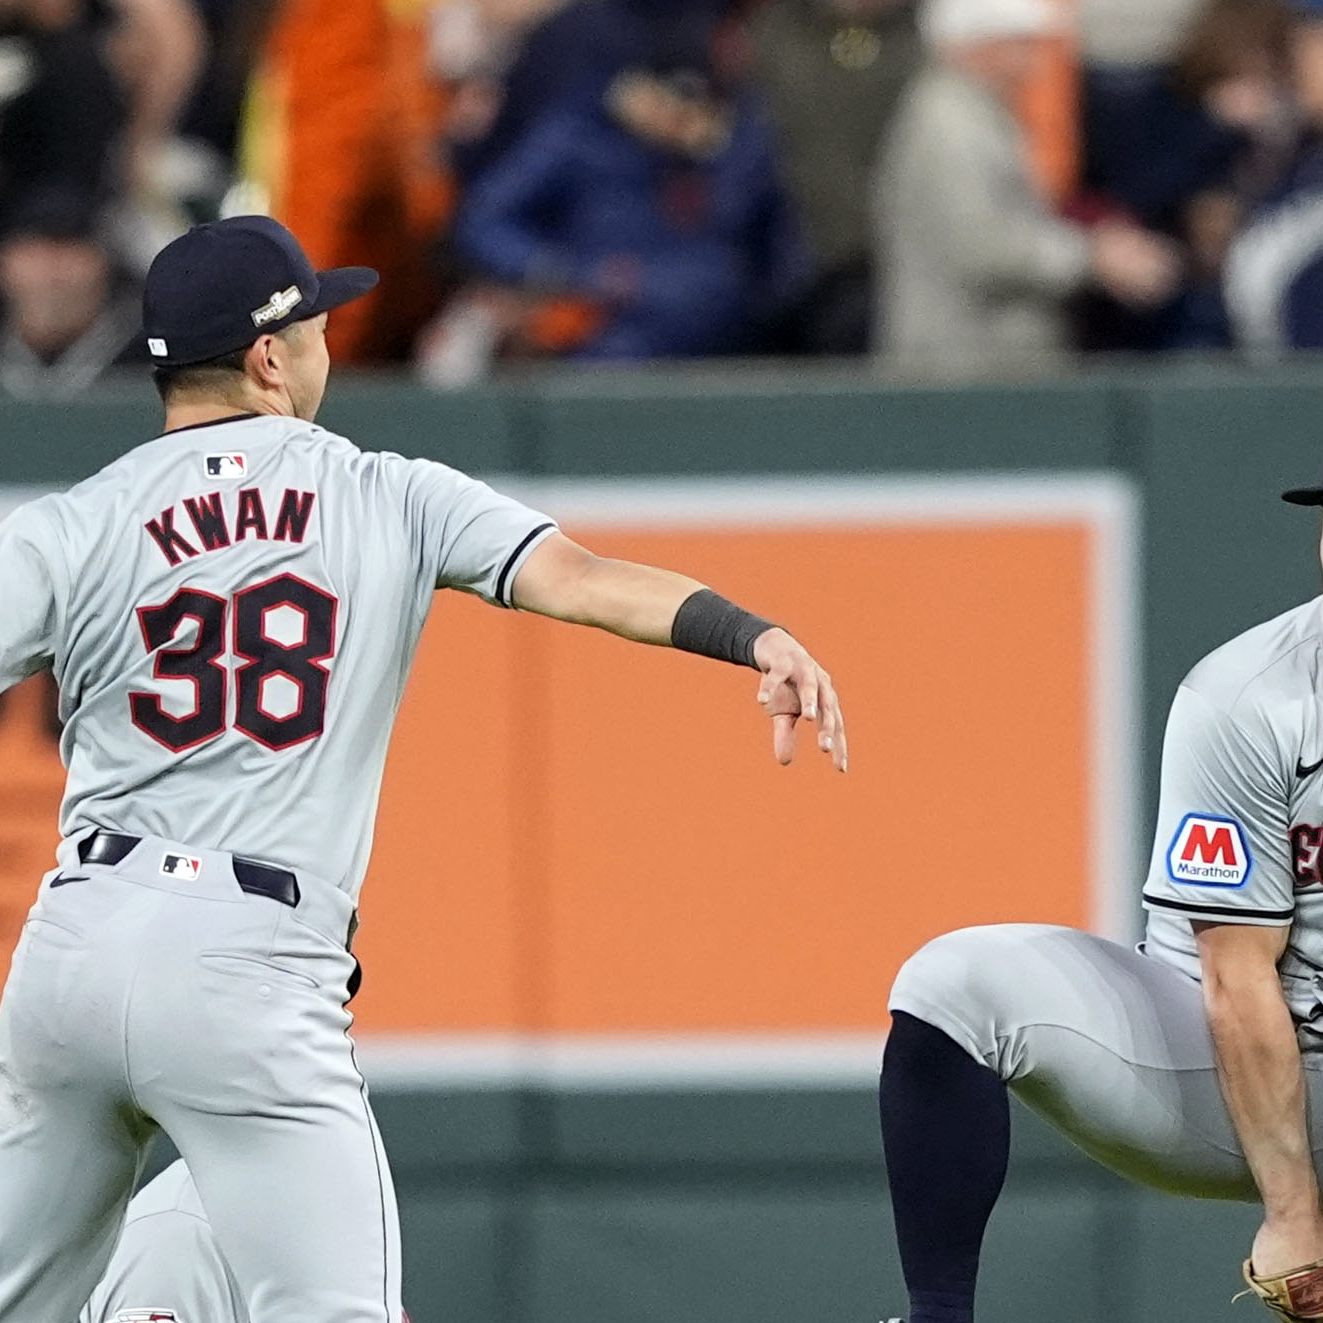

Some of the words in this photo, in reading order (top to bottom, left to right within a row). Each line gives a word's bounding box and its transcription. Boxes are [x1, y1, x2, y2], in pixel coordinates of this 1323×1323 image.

[144, 487, 316, 567] KWAN
[128, 572, 339, 754] 38
[1177, 863, 1240, 879] Marathon
[1180, 824, 1237, 866] M
